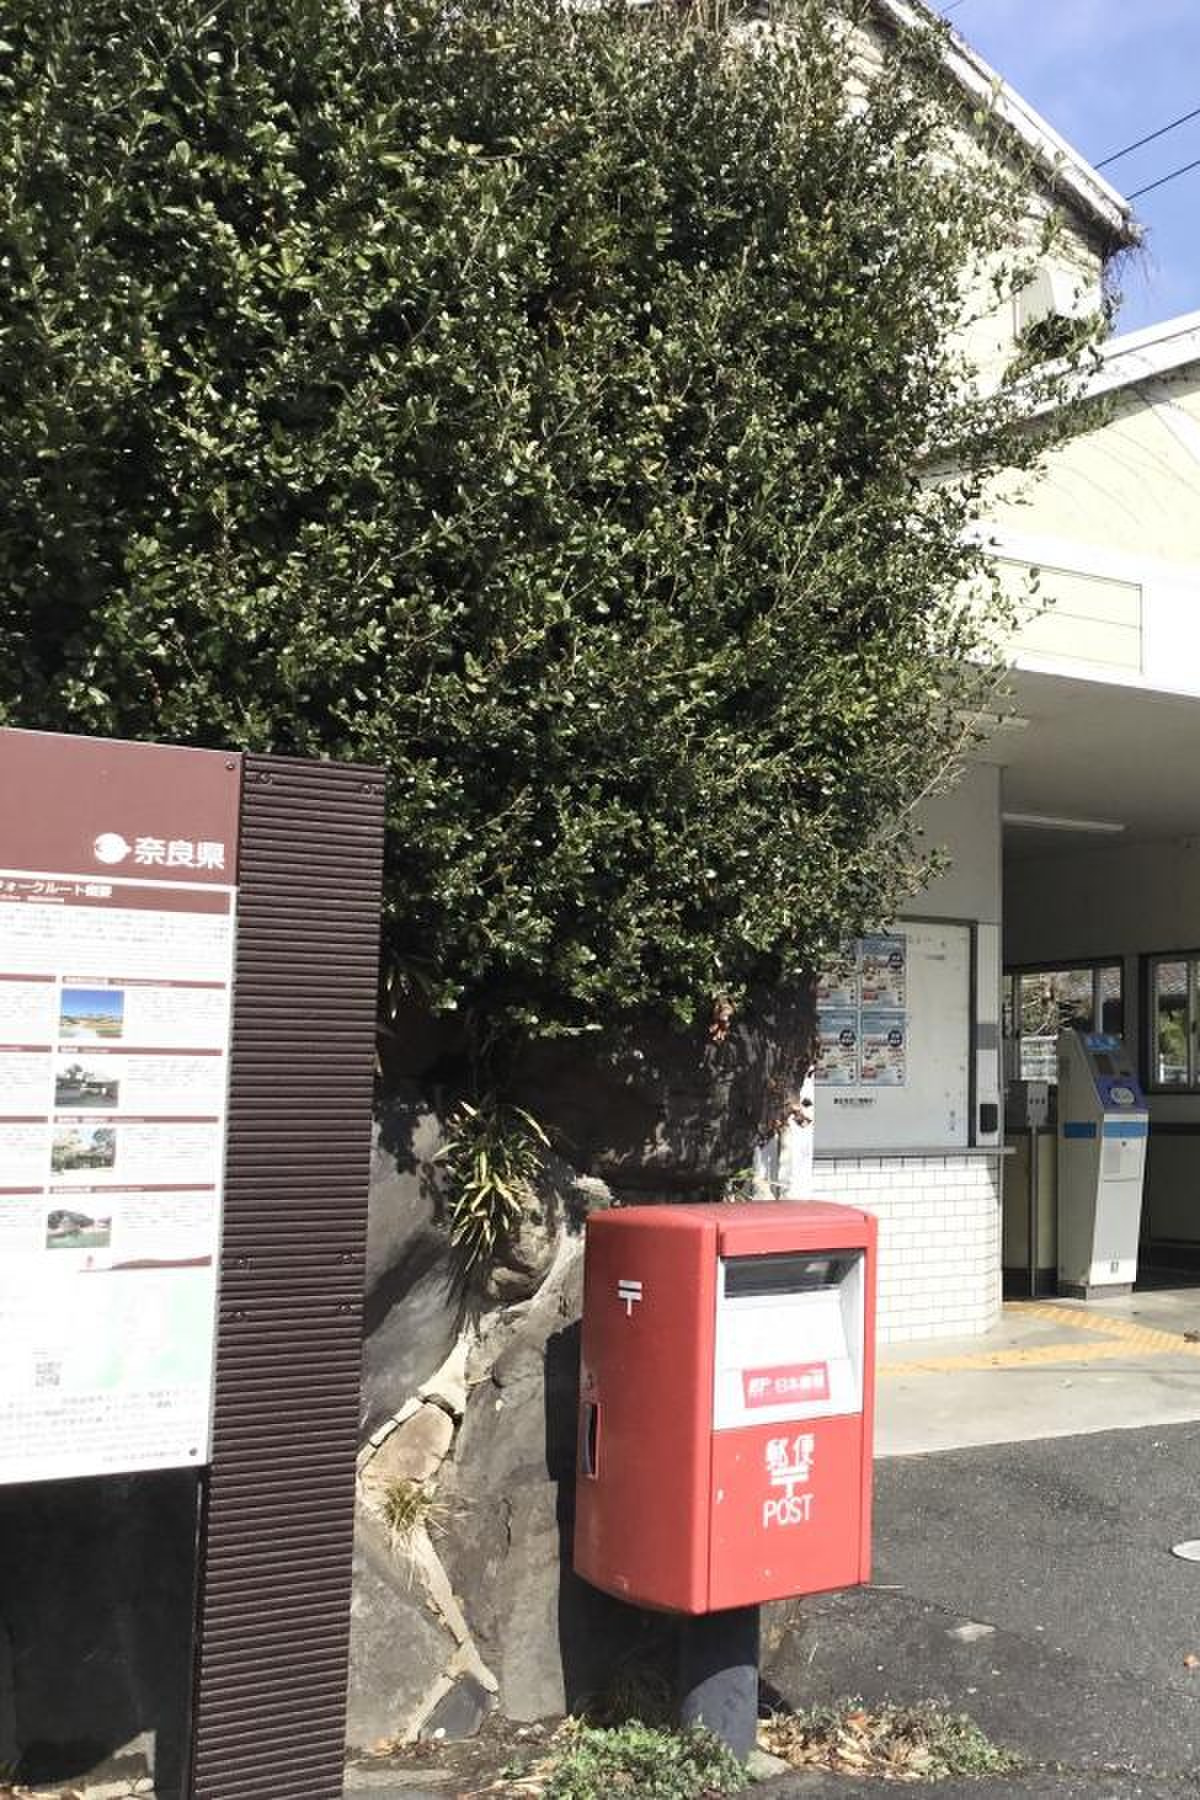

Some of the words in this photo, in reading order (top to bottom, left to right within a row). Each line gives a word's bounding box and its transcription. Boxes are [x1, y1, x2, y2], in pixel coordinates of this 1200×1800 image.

[134, 836, 225, 870] 奈良県
[764, 1433, 815, 1470] 郵便
[762, 1493, 815, 1529] POST
